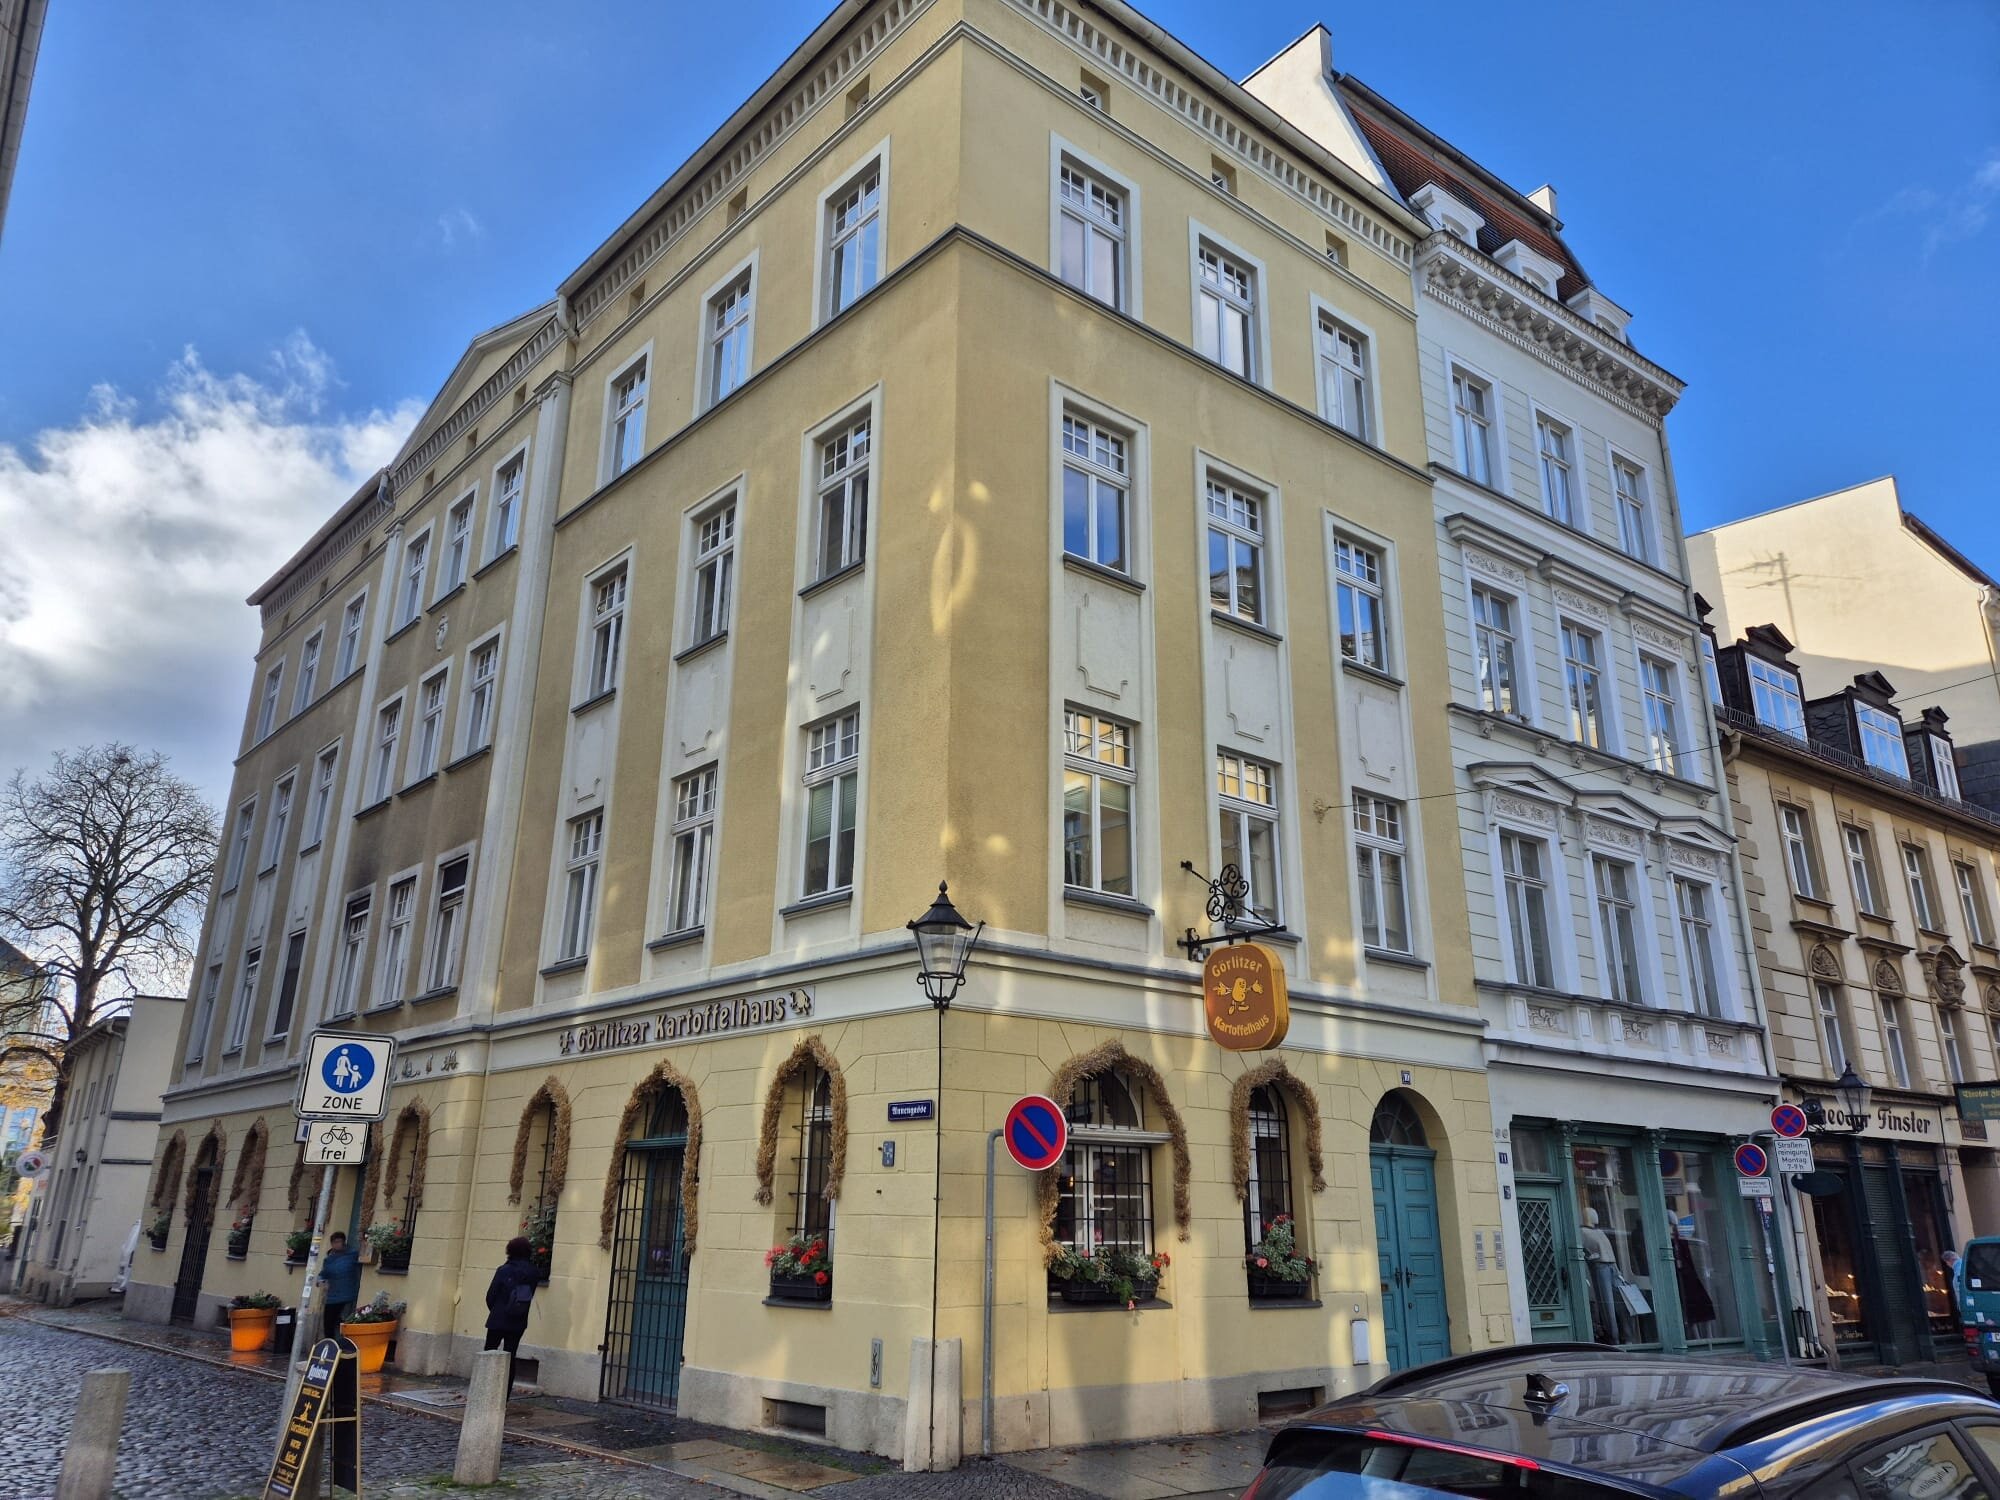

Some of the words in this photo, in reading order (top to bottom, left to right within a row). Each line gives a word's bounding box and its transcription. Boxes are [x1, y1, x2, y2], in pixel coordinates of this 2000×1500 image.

[1212, 956, 1263, 977] Görlitzer
[576, 1021, 649, 1051] Görlitzer
[654, 997, 786, 1040] Kartoffelhaus
[1214, 1014, 1270, 1036] Kartoffelhaus
[322, 1096, 363, 1110] ZONE
[1877, 1107, 1931, 1133] Finster
[321, 1146, 347, 1160] frei
